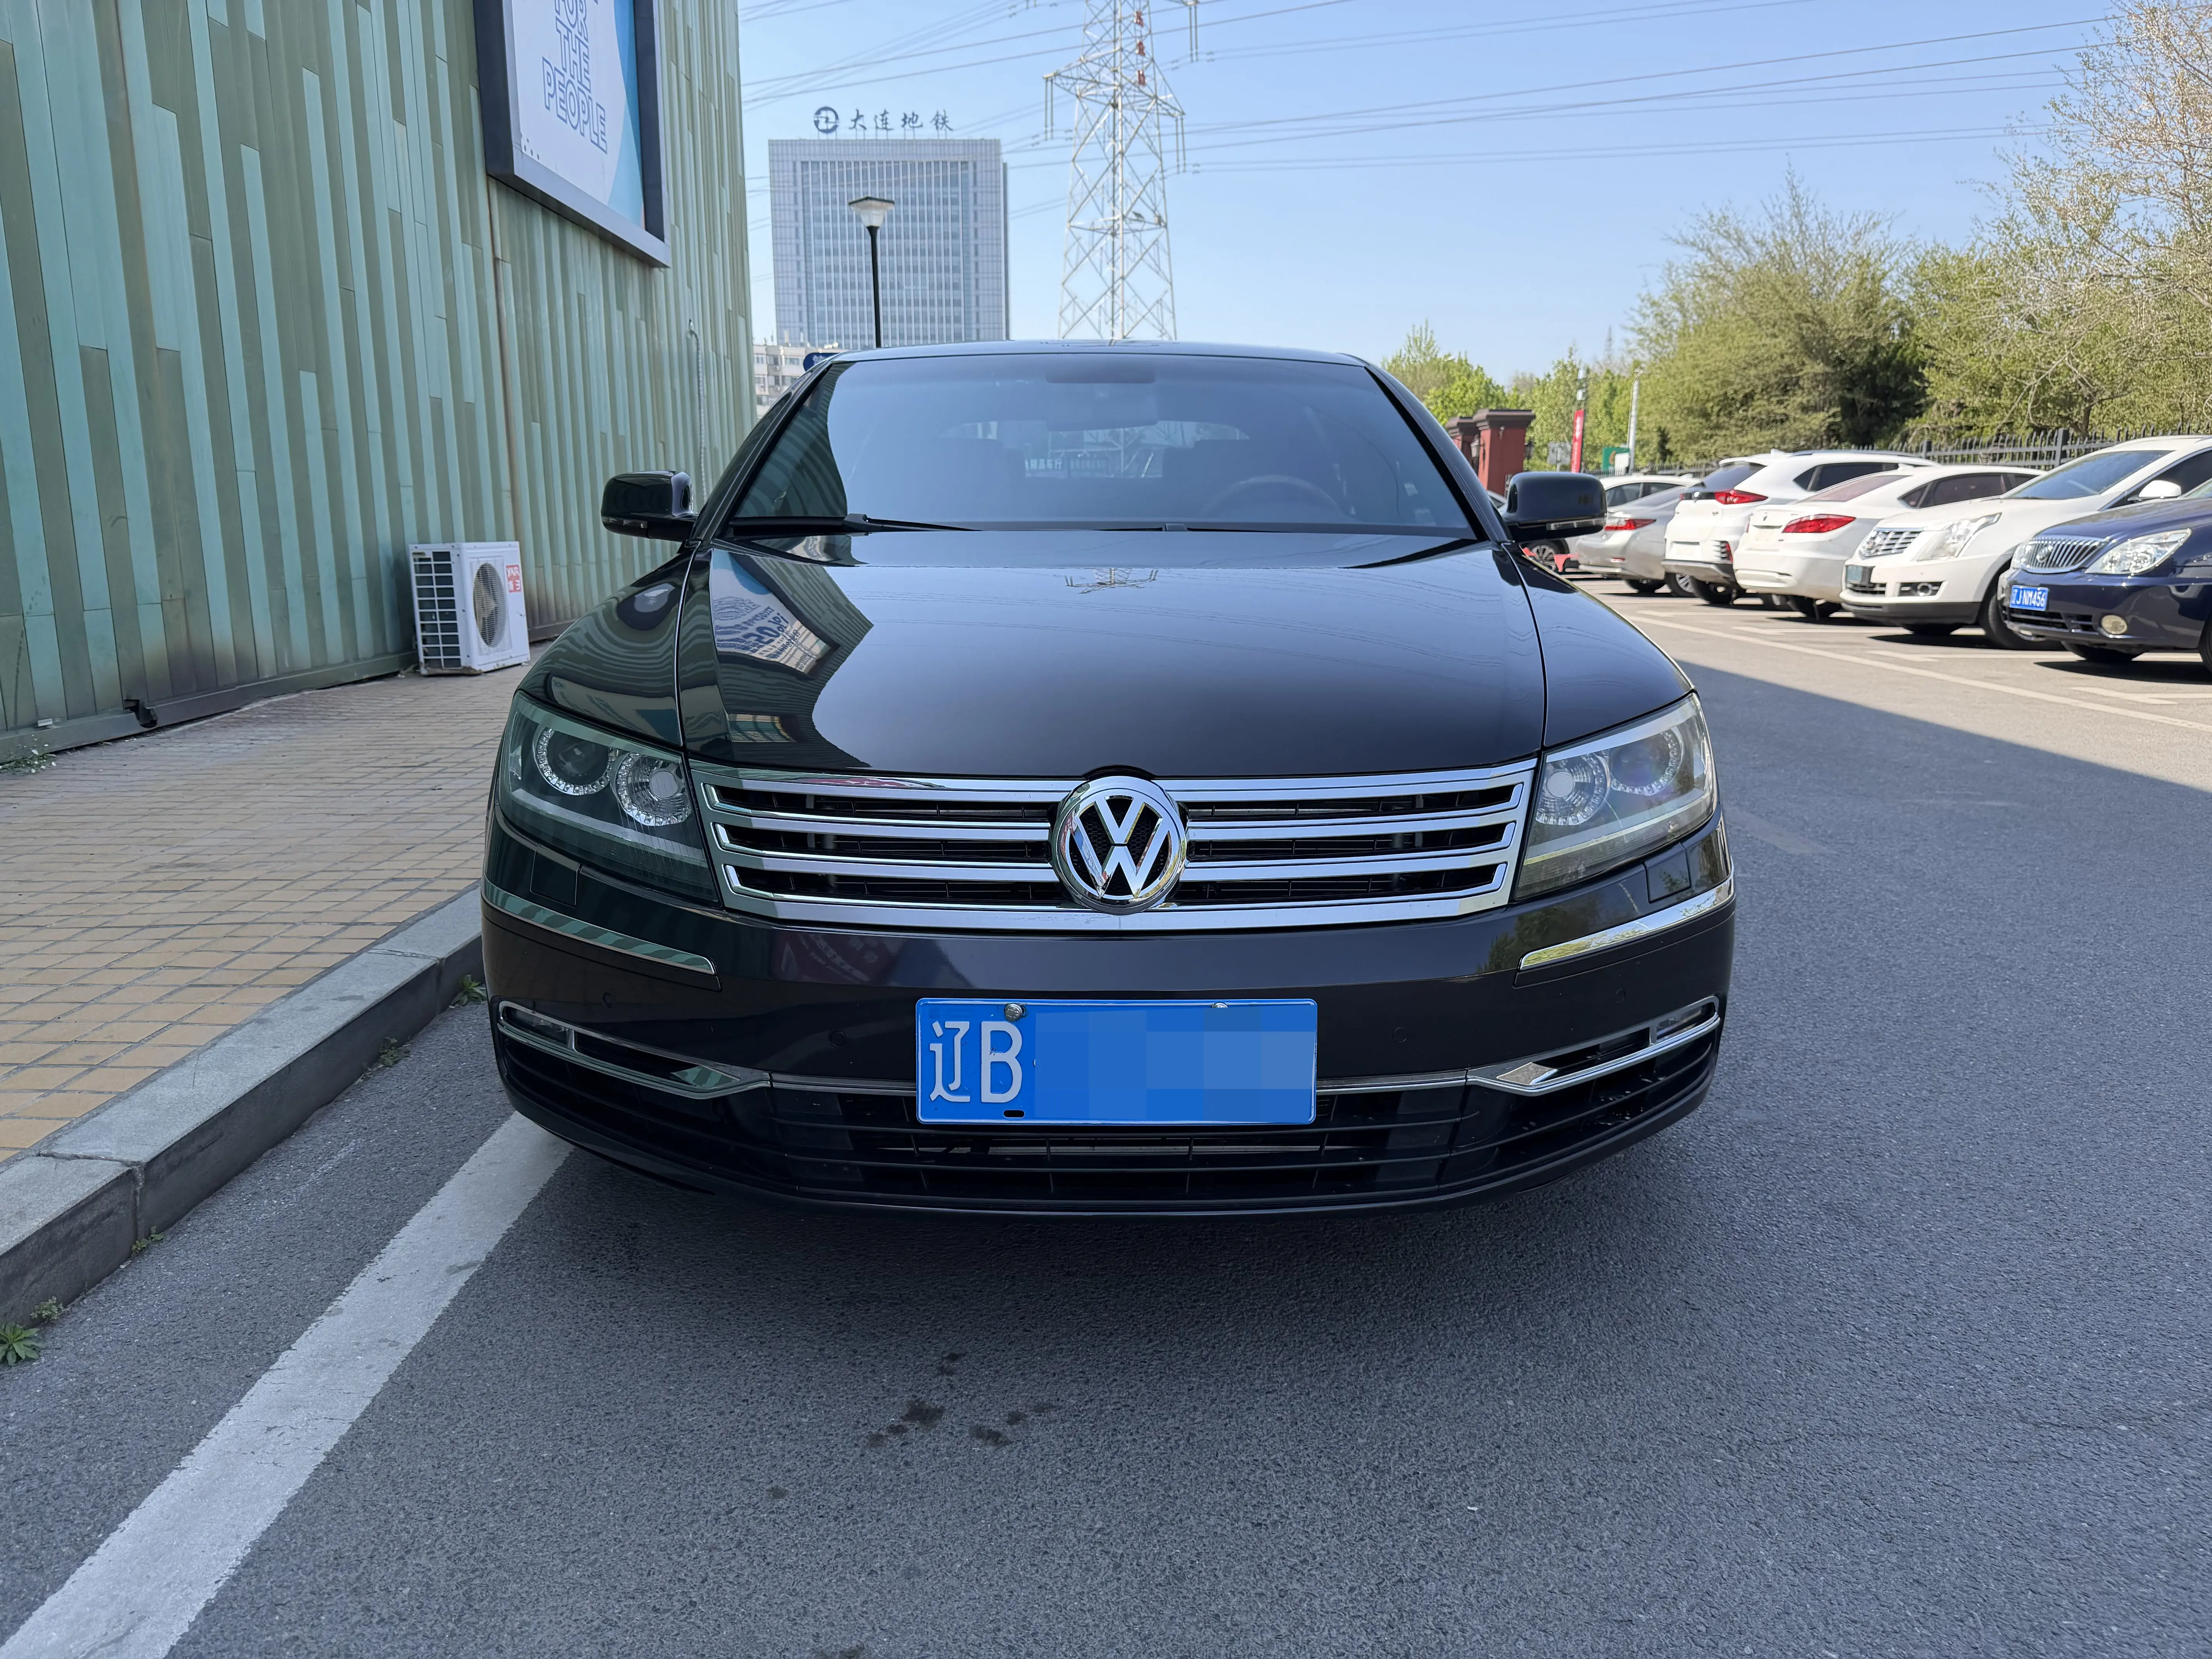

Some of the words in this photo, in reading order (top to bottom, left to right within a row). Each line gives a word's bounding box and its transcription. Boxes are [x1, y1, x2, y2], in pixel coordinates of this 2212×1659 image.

[555, 0, 588, 43] OR
[555, 16, 591, 93] THE
[543, 57, 608, 154] PEOPLE
[848, 108, 953, 131] 大连地铁
